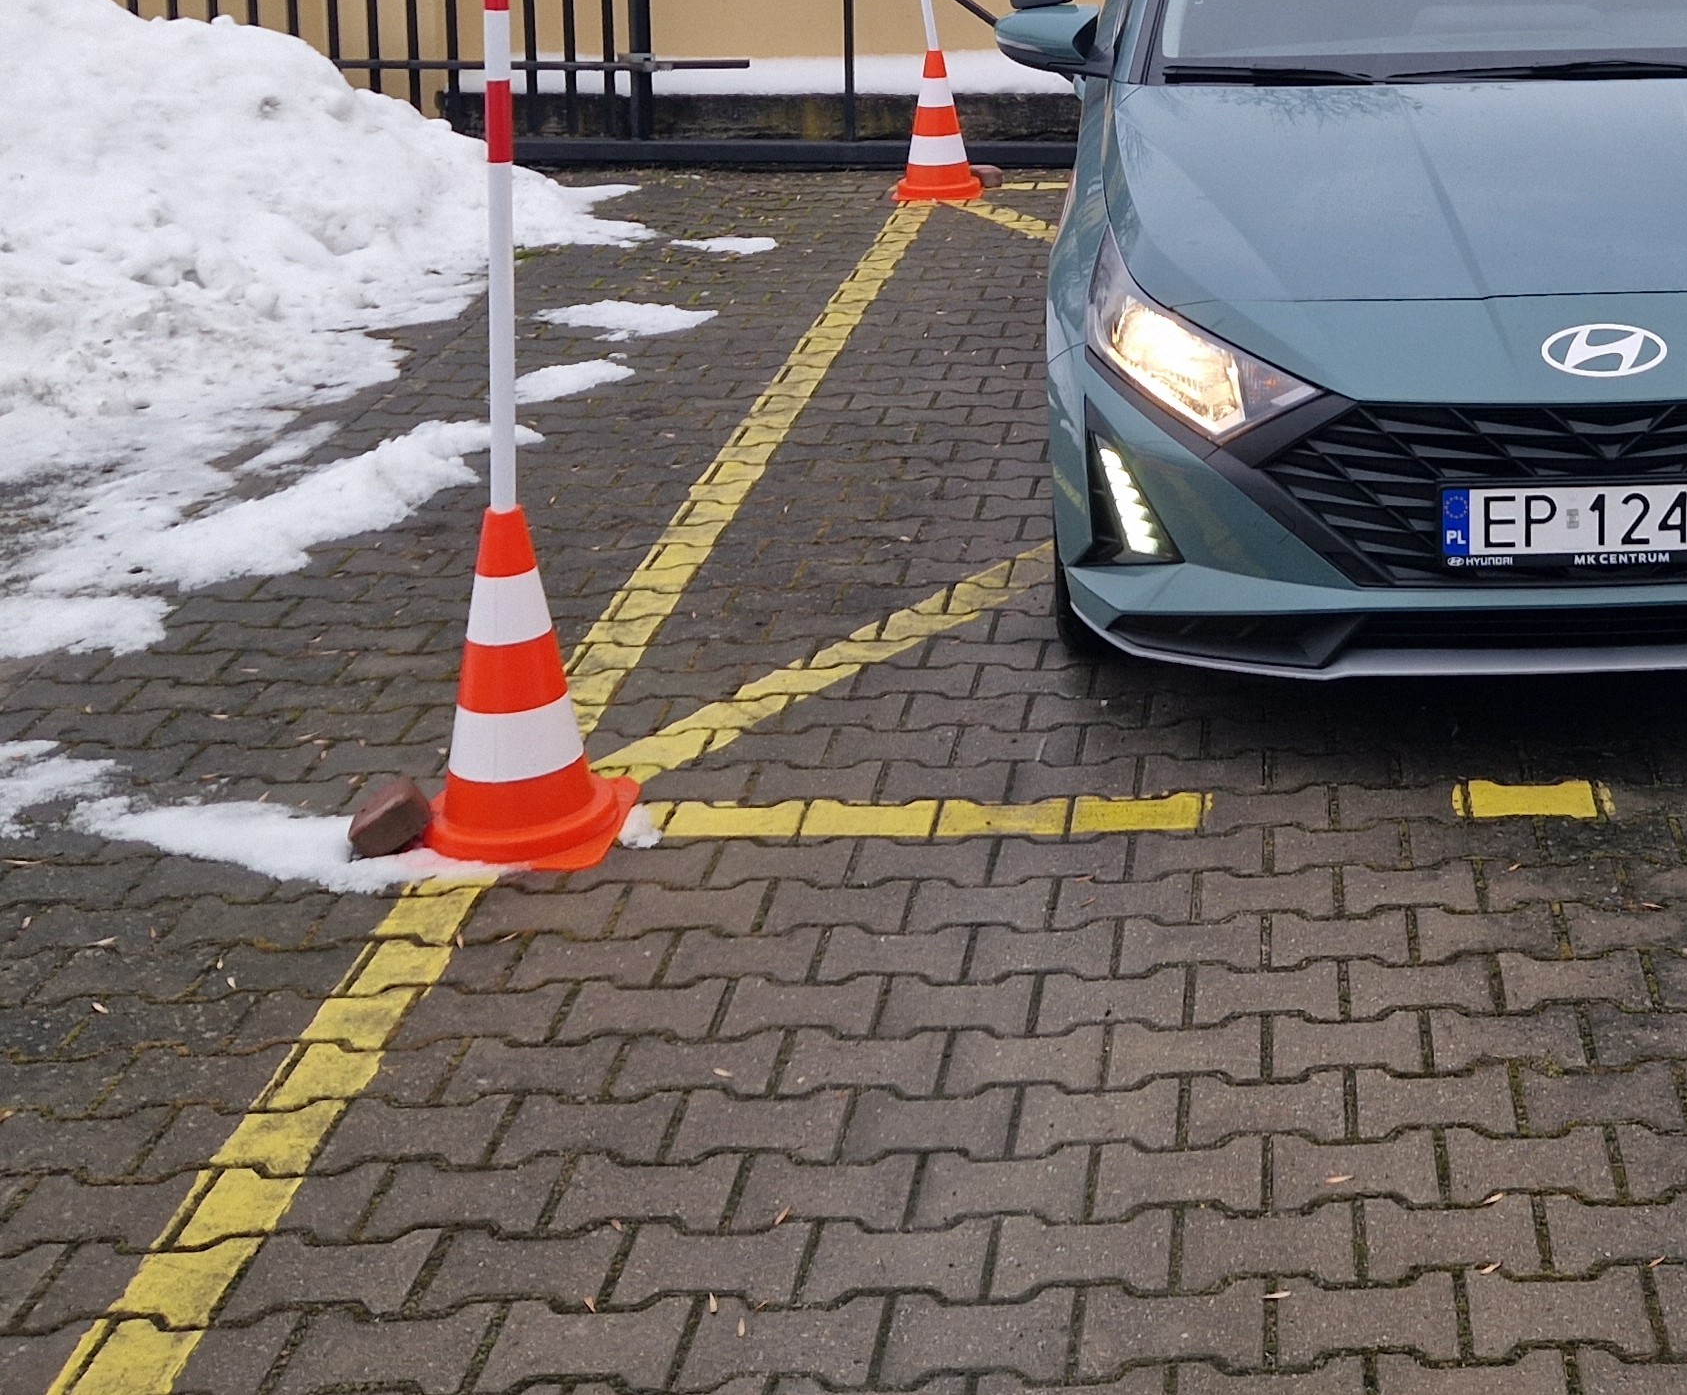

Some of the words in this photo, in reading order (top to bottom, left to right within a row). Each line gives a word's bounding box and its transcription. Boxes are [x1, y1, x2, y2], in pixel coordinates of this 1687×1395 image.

[1484, 495, 1557, 548] EP
[1446, 531, 1467, 545] PL
[1465, 557, 1514, 566] HYUNDAI
[1574, 555, 1596, 565] MK
[1599, 552, 1671, 564] CENTRUM
